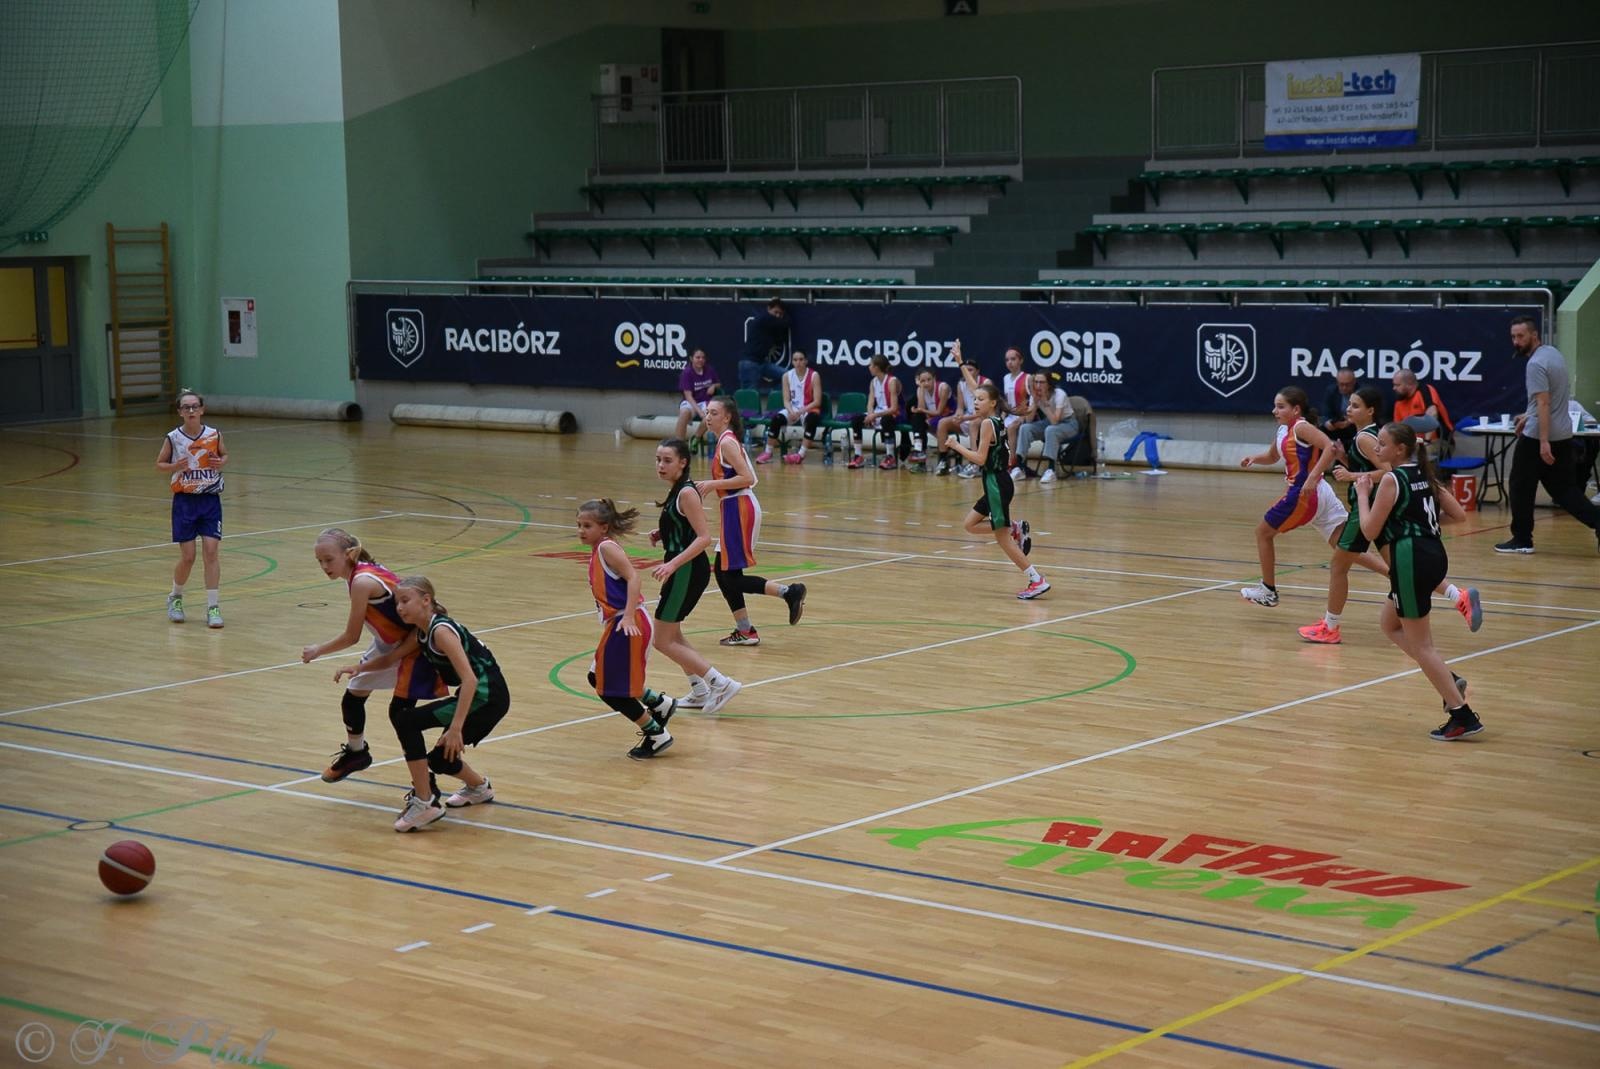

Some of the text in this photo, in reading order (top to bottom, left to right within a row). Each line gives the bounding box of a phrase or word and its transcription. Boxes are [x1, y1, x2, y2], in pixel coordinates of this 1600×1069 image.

[445, 322, 561, 355] RACIBÓRZ
[615, 322, 688, 357] OSiR
[816, 331, 959, 368] RACIBÓRZ
[1030, 330, 1123, 371] OSiR
[644, 357, 687, 370] RACIBÓRZ
[1066, 370, 1123, 384] RACIBÓRZ
[1291, 339, 1482, 382] RACIBÓRZ
[182, 469, 214, 481] MINI
[1459, 479, 1473, 503] 5
[866, 817, 1418, 929] Arena
[1042, 822, 1473, 897] RAFAKO
